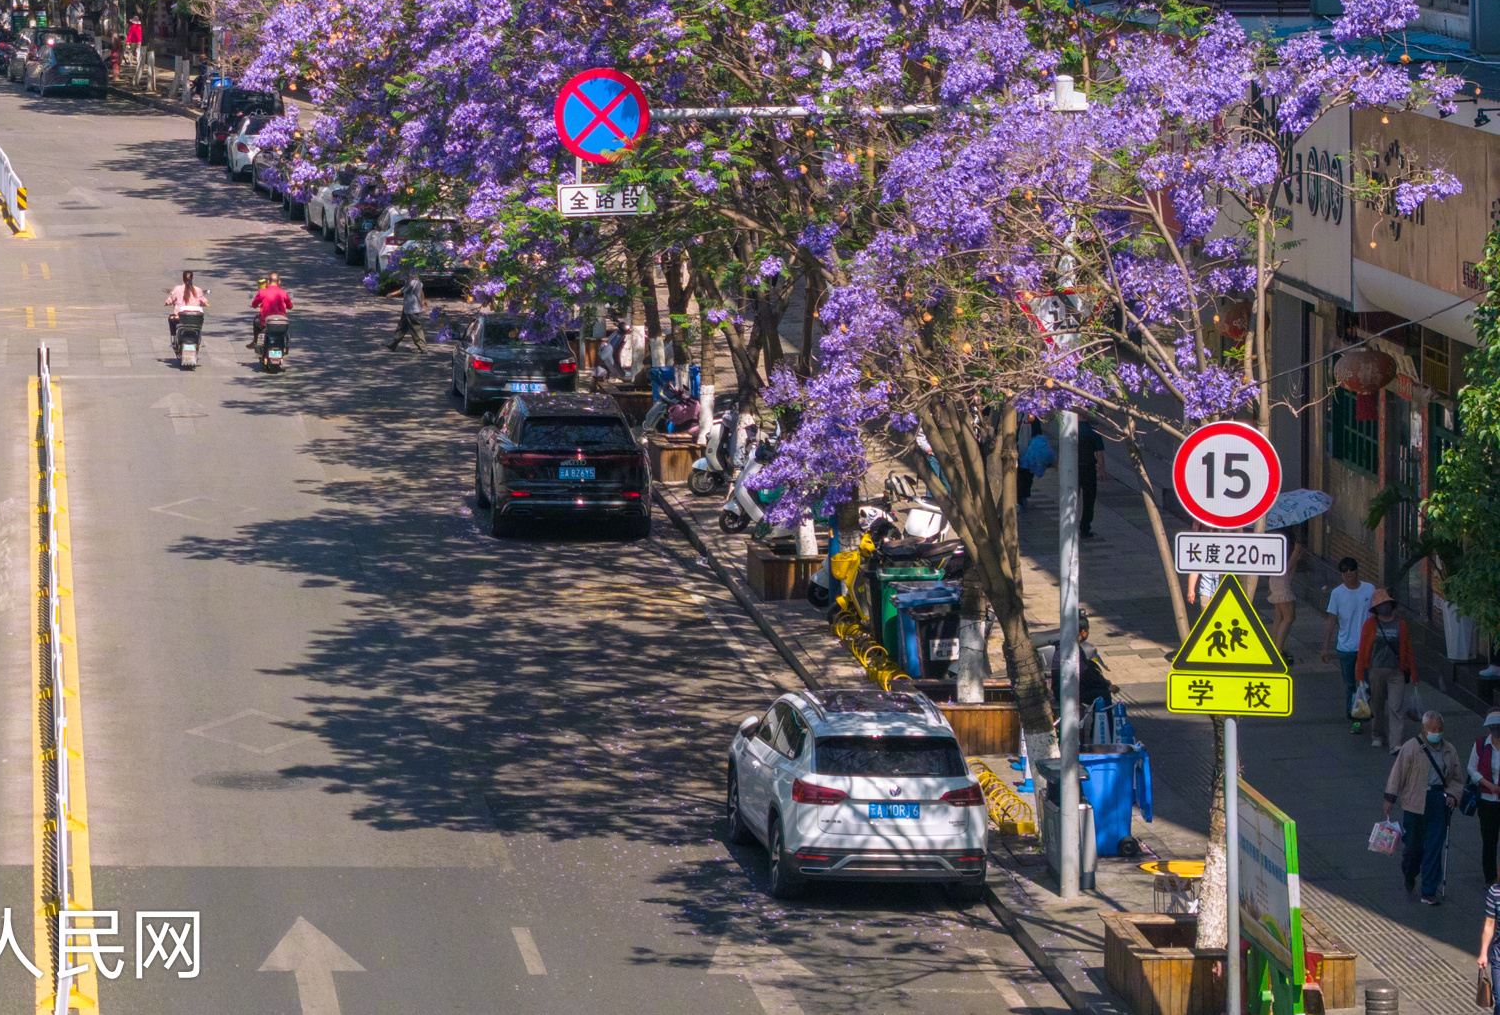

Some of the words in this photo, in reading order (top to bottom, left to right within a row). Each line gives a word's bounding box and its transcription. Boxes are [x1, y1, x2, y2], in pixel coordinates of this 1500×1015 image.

[570, 187, 640, 210] 全路段
[1201, 452, 1251, 499] 15
[1186, 543, 1276, 566] 长度220m
[1187, 680, 1271, 709] 学校
